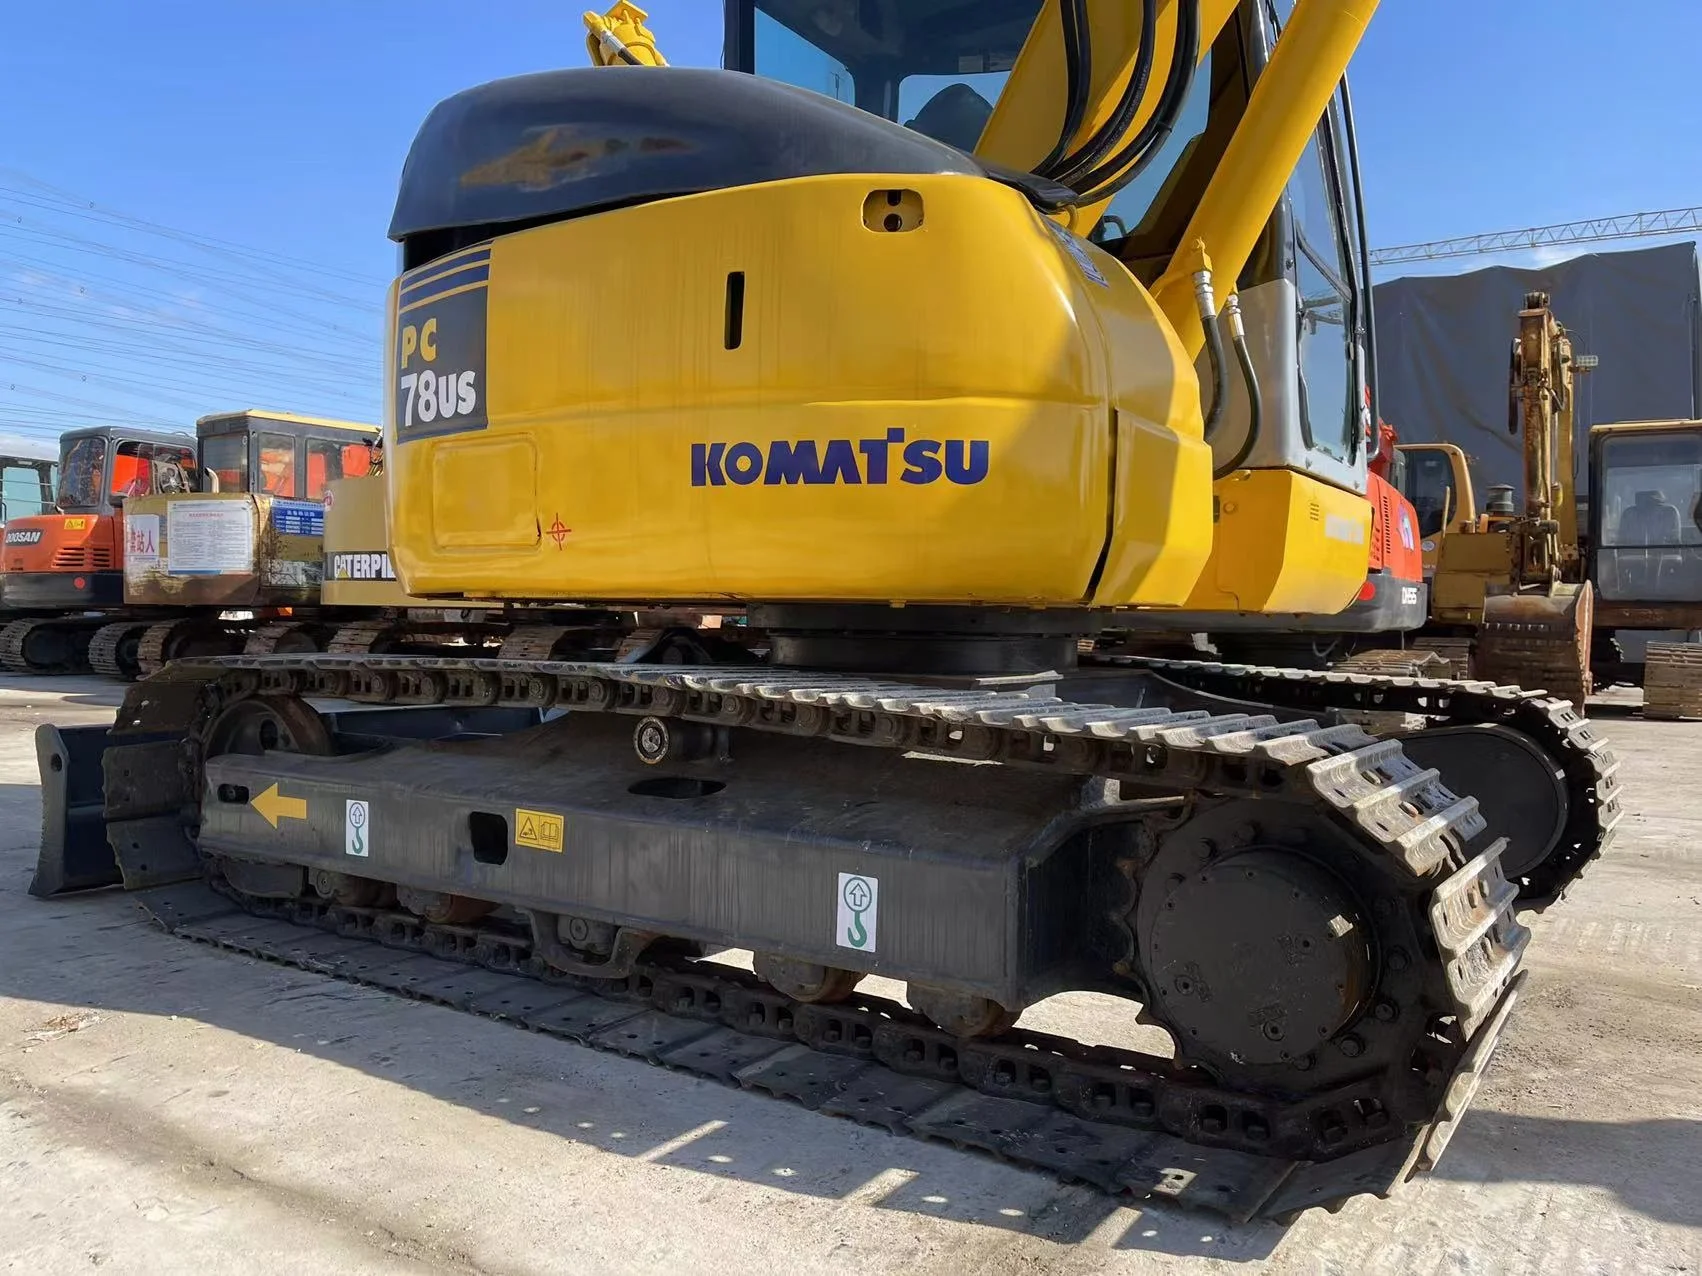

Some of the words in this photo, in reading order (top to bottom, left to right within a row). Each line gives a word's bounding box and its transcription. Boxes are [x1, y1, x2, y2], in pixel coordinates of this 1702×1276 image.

[400, 318, 437, 368] PC
[400, 369, 476, 426] 78US
[691, 427, 989, 486] KOMATSU
